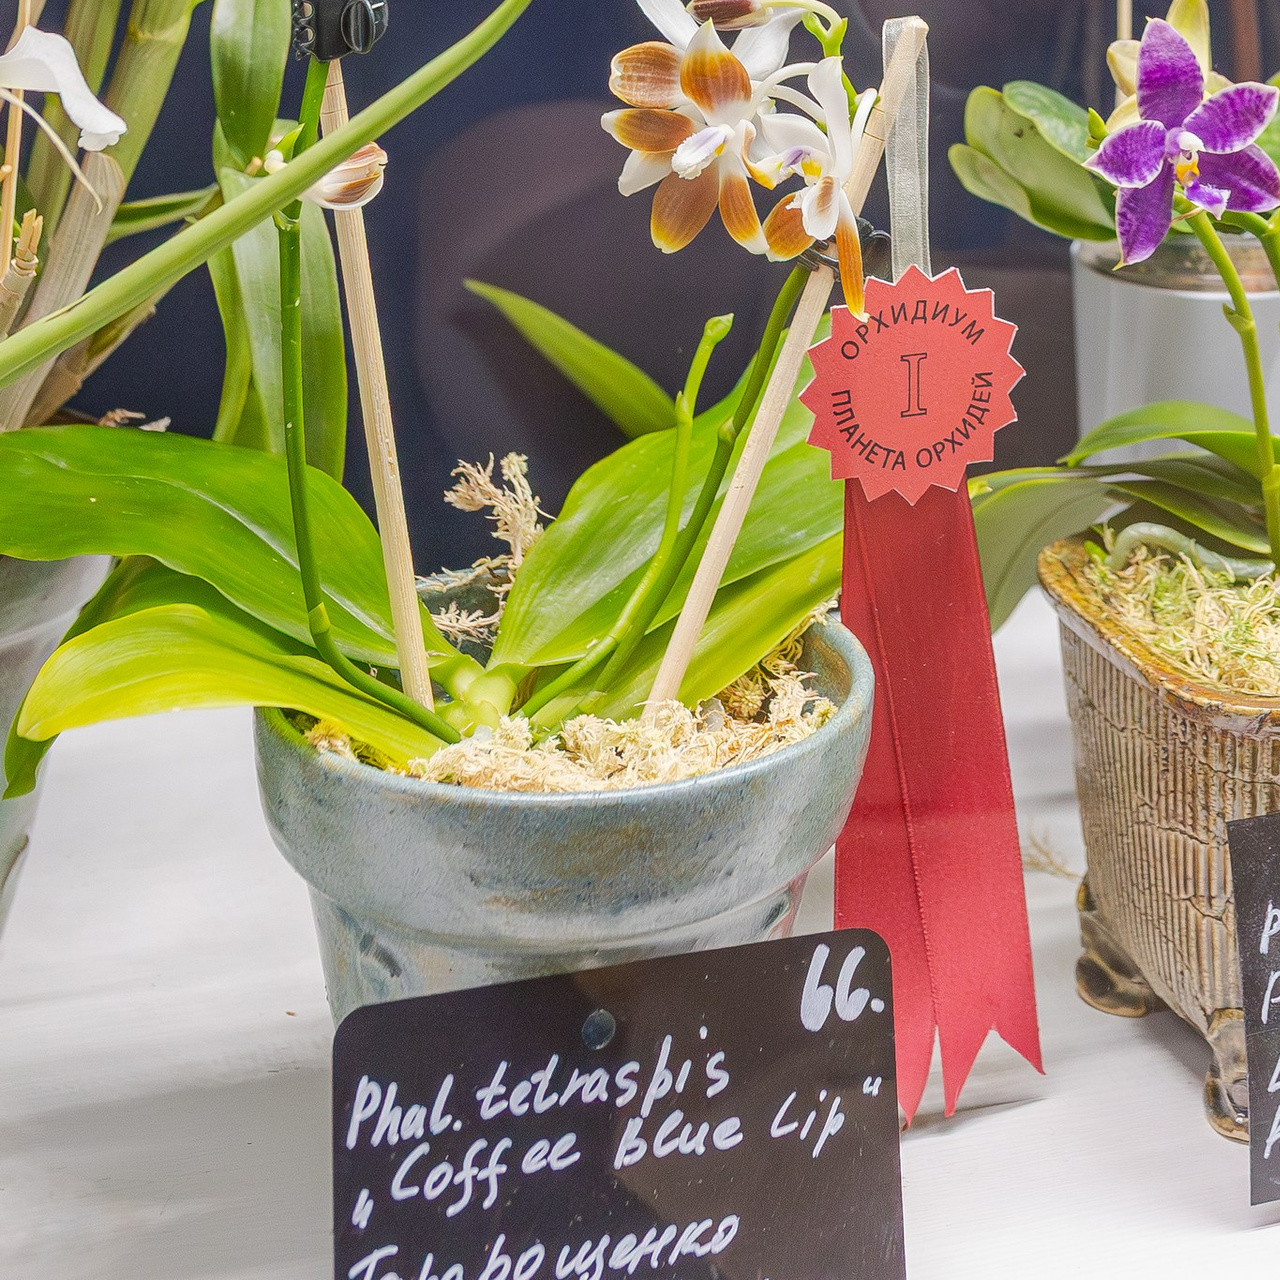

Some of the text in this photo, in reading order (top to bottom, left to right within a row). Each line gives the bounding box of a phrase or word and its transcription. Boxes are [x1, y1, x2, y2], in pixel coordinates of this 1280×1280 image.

[841, 300, 985, 360] ОРХИДИУМ
[831, 371, 994, 471] ПЛАНЕТА ОРХИДЕЙ
[900, 352, 928, 418] I
[800, 943, 884, 1032] 66.
[346, 1026, 730, 1149] Phal. tetraspis
